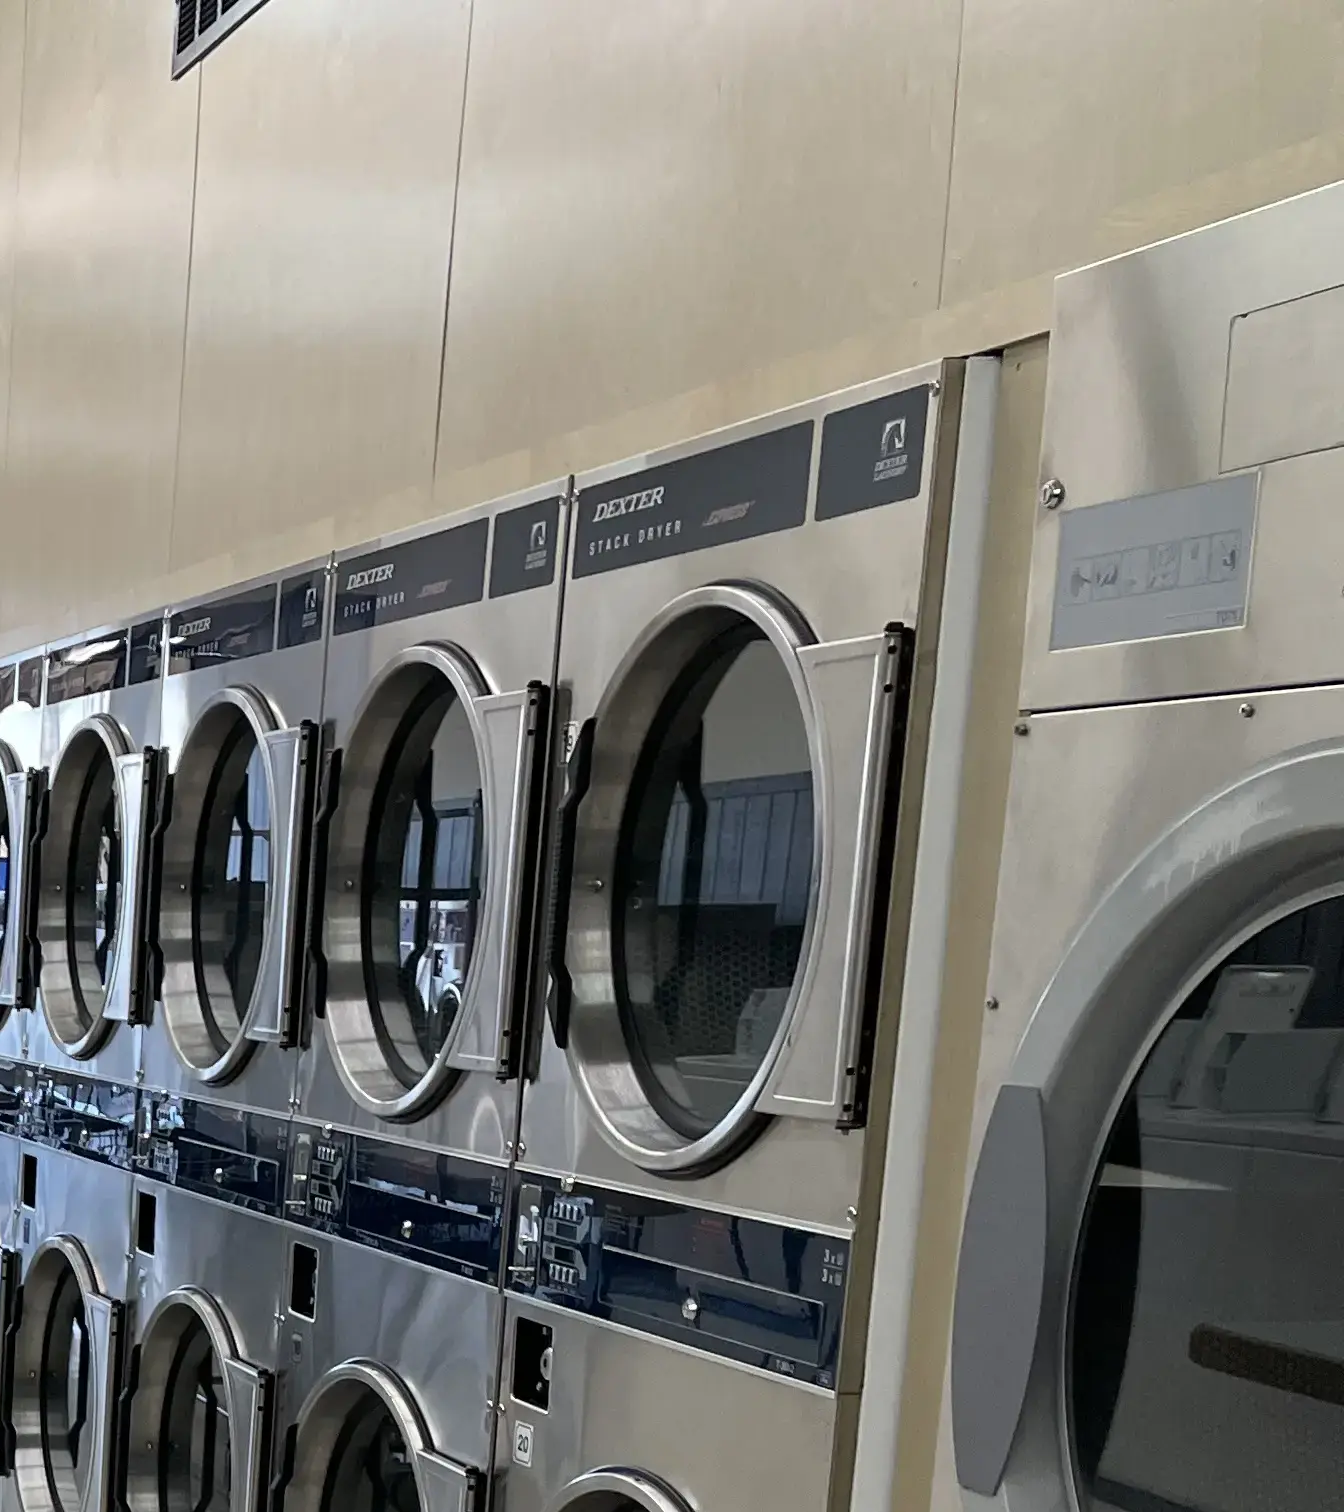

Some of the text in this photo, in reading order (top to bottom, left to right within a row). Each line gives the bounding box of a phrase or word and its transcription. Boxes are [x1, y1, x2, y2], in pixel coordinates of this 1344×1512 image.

[592, 486, 665, 523] DEXTER
[589, 520, 682, 556] STACK DRYER
[346, 563, 395, 591] DEXTER
[343, 591, 405, 618] STACK DRYER
[517, 1434, 529, 1454] 20
